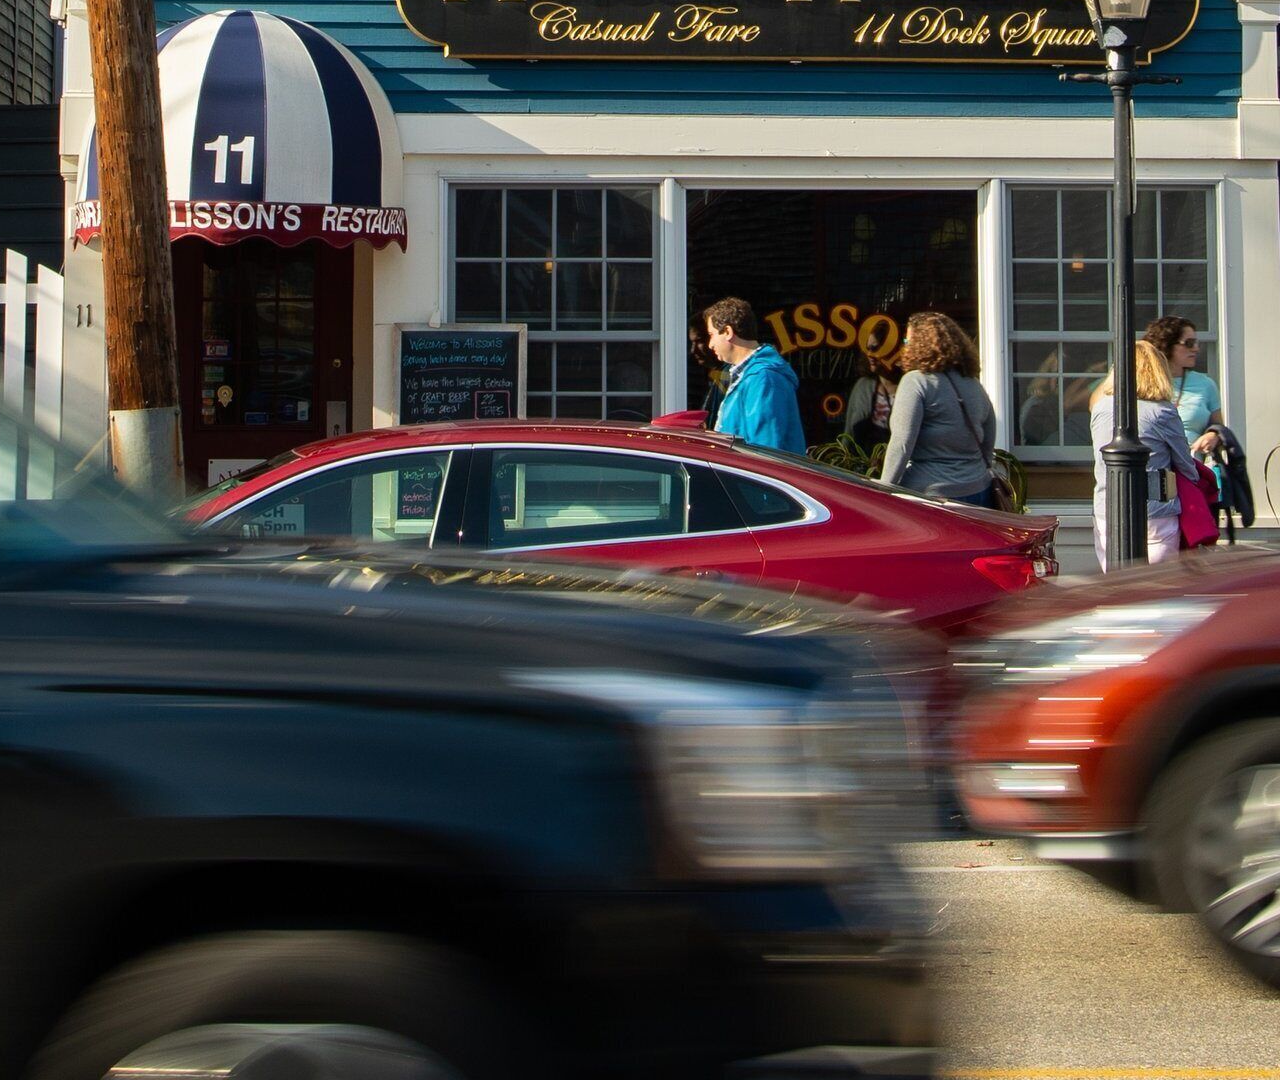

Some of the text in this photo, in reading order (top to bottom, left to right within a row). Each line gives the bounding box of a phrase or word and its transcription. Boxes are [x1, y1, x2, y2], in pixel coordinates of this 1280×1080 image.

[529, 1, 761, 44] Casual Fare
[852, 6, 1100, 57] 11 Dock Squar
[204, 135, 256, 186] 11
[169, 201, 302, 231] LISSON'S
[76, 303, 92, 328] 11
[409, 338, 448, 351] Welcome
[450, 339, 461, 349] to
[764, 302, 902, 371] ISSO
[404, 378, 419, 390] We
[421, 377, 439, 388] have
[441, 376, 454, 388] the
[407, 391, 471, 404] of CRAFT BEER
[480, 393, 497, 405] 22
[410, 406, 419, 415] in
